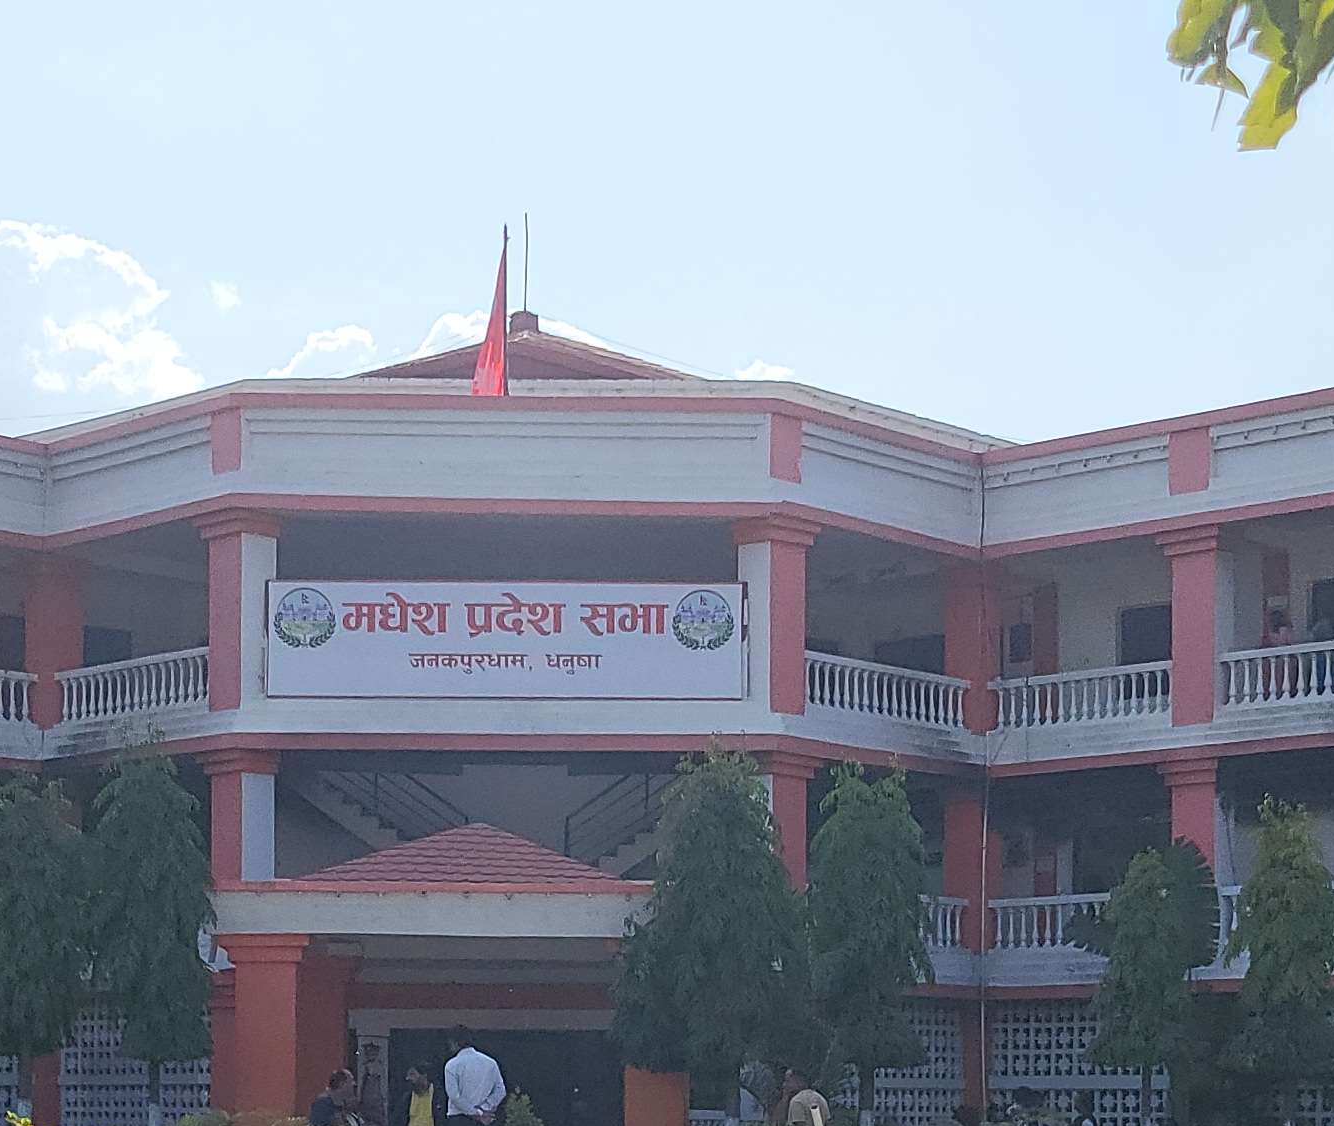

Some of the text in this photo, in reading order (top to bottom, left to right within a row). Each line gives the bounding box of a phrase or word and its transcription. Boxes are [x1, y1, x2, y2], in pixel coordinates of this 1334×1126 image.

[342, 592, 668, 638] मधेश प्रदेश सभा
[409, 652, 603, 675] जनकपुरधाम, धनुषा
